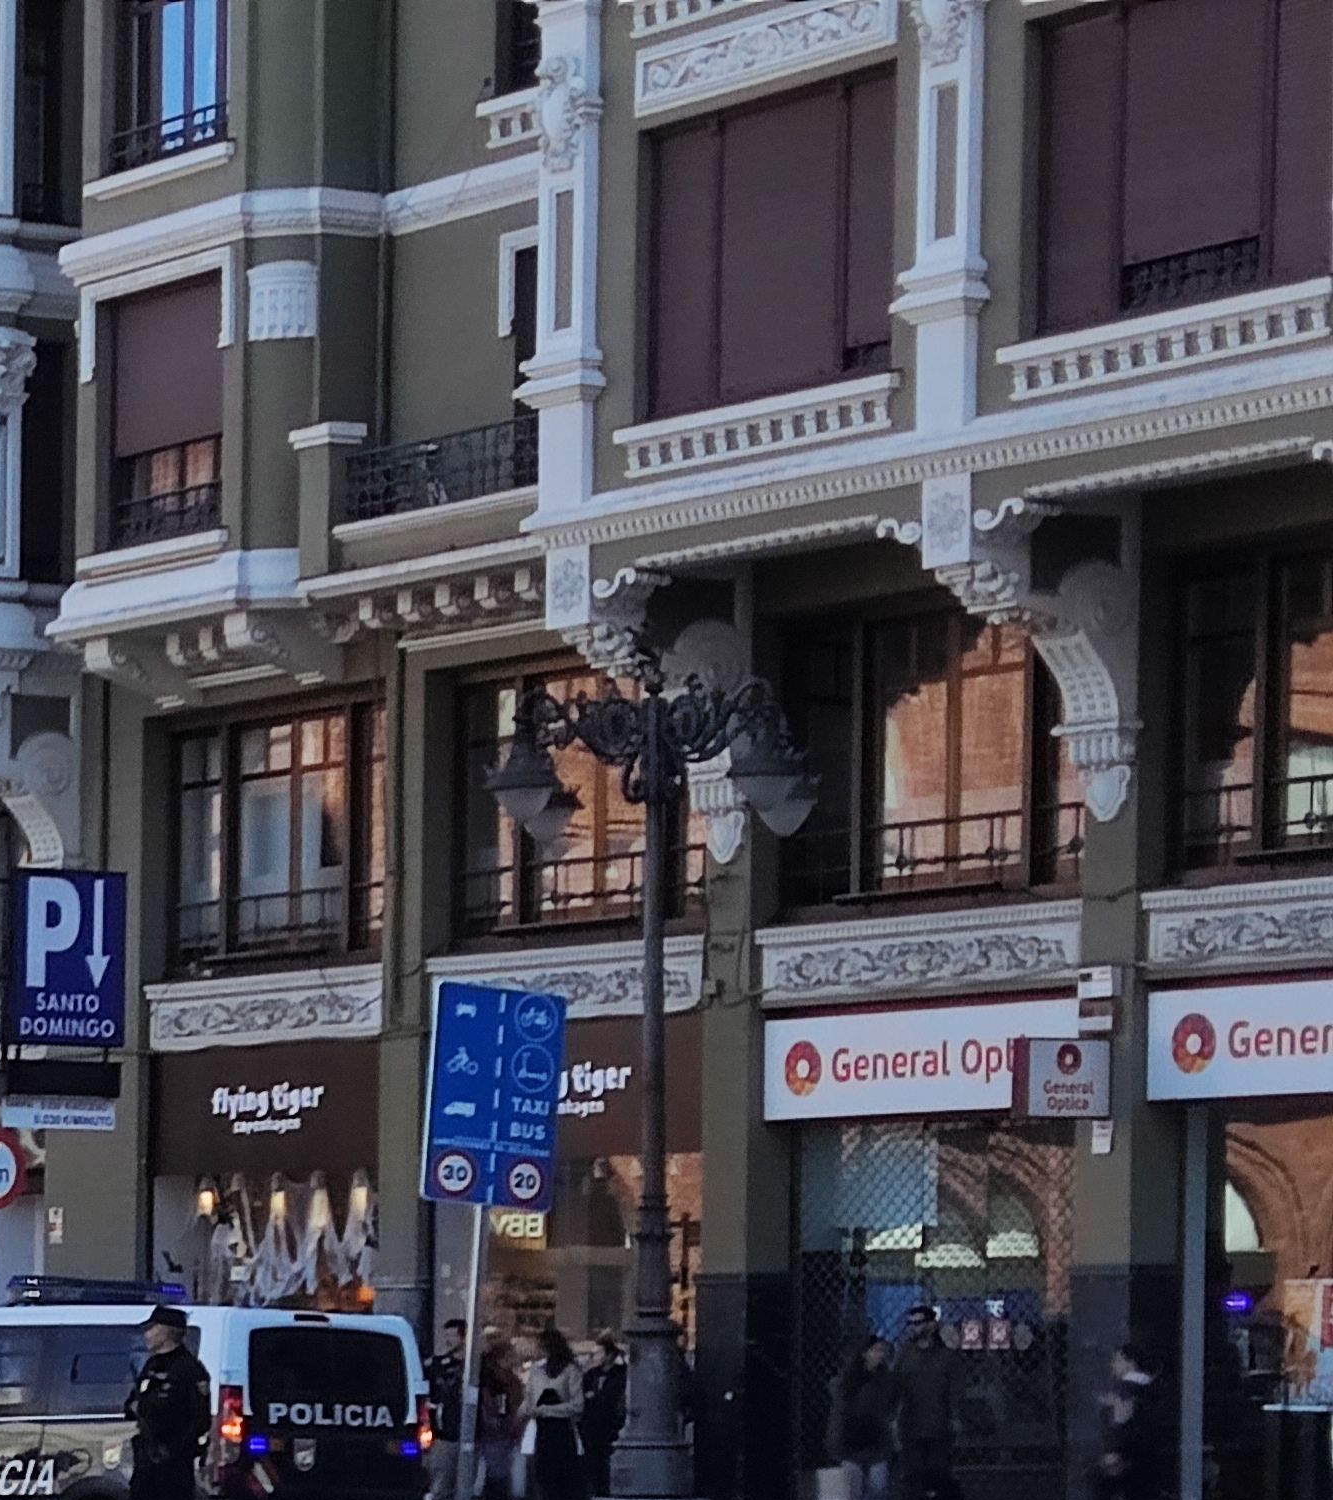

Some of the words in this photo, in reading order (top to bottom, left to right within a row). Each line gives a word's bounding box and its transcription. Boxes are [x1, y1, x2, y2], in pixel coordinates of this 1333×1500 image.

[25, 875, 82, 988] P
[35, 992, 100, 1013] SANTO
[19, 1016, 115, 1038] DOMINGO
[832, 1040, 951, 1083] General
[572, 1061, 632, 1099] tiger
[1043, 1079, 1095, 1095] General
[212, 1085, 270, 1121] flying
[272, 1081, 325, 1116] tiger
[511, 1096, 550, 1116] TAXI
[510, 1122, 546, 1140] BUS
[442, 1164, 469, 1182] 30
[513, 1171, 537, 1190] 20
[268, 1402, 395, 1428] POLICIA
